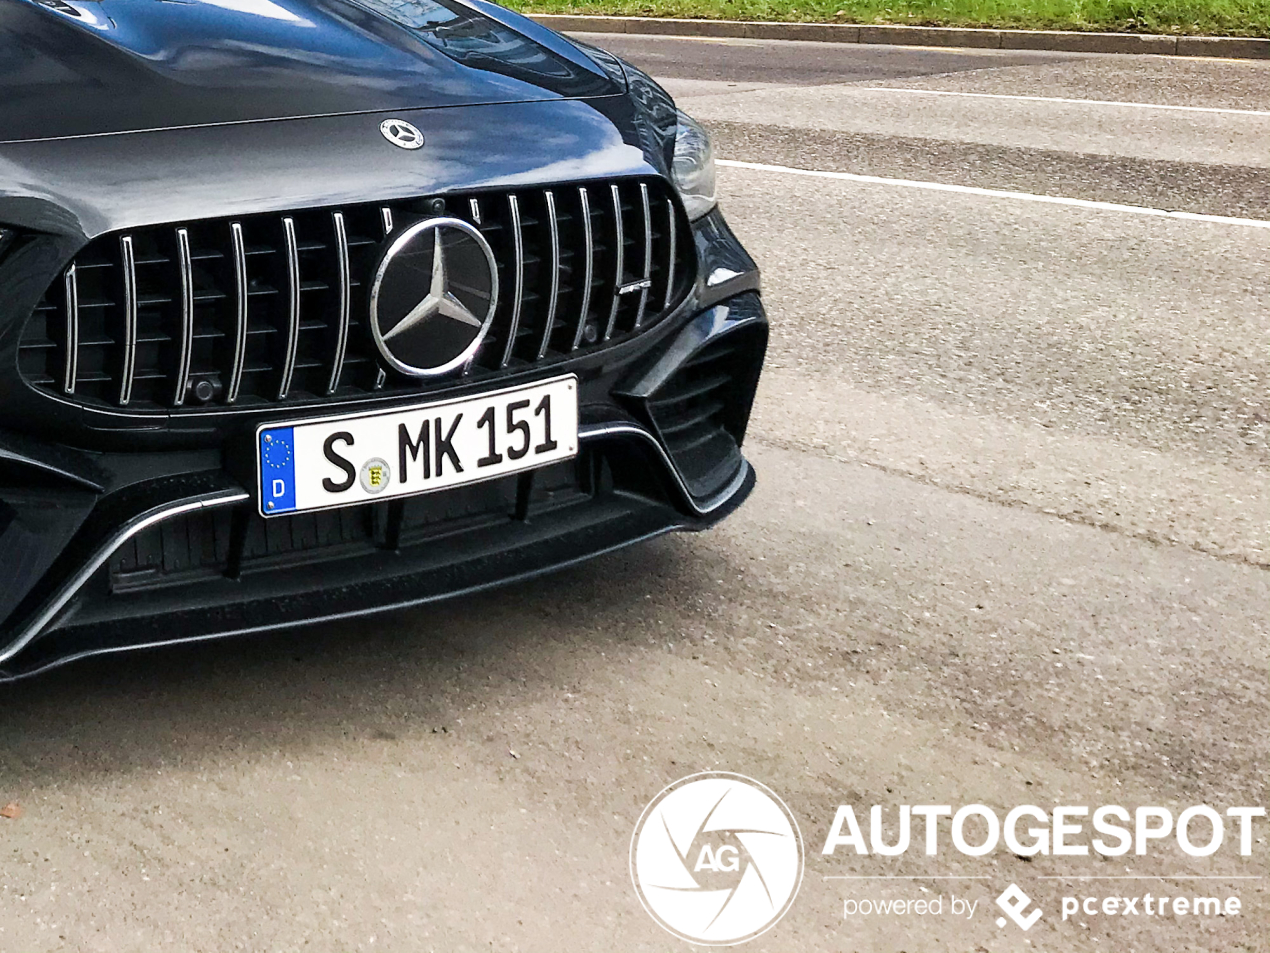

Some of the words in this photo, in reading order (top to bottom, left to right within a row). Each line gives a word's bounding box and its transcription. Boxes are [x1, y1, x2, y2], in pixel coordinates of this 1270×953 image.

[322, 431, 356, 493] S
[398, 413, 464, 483] MK
[477, 394, 558, 468] 151
[272, 479, 285, 498] D
